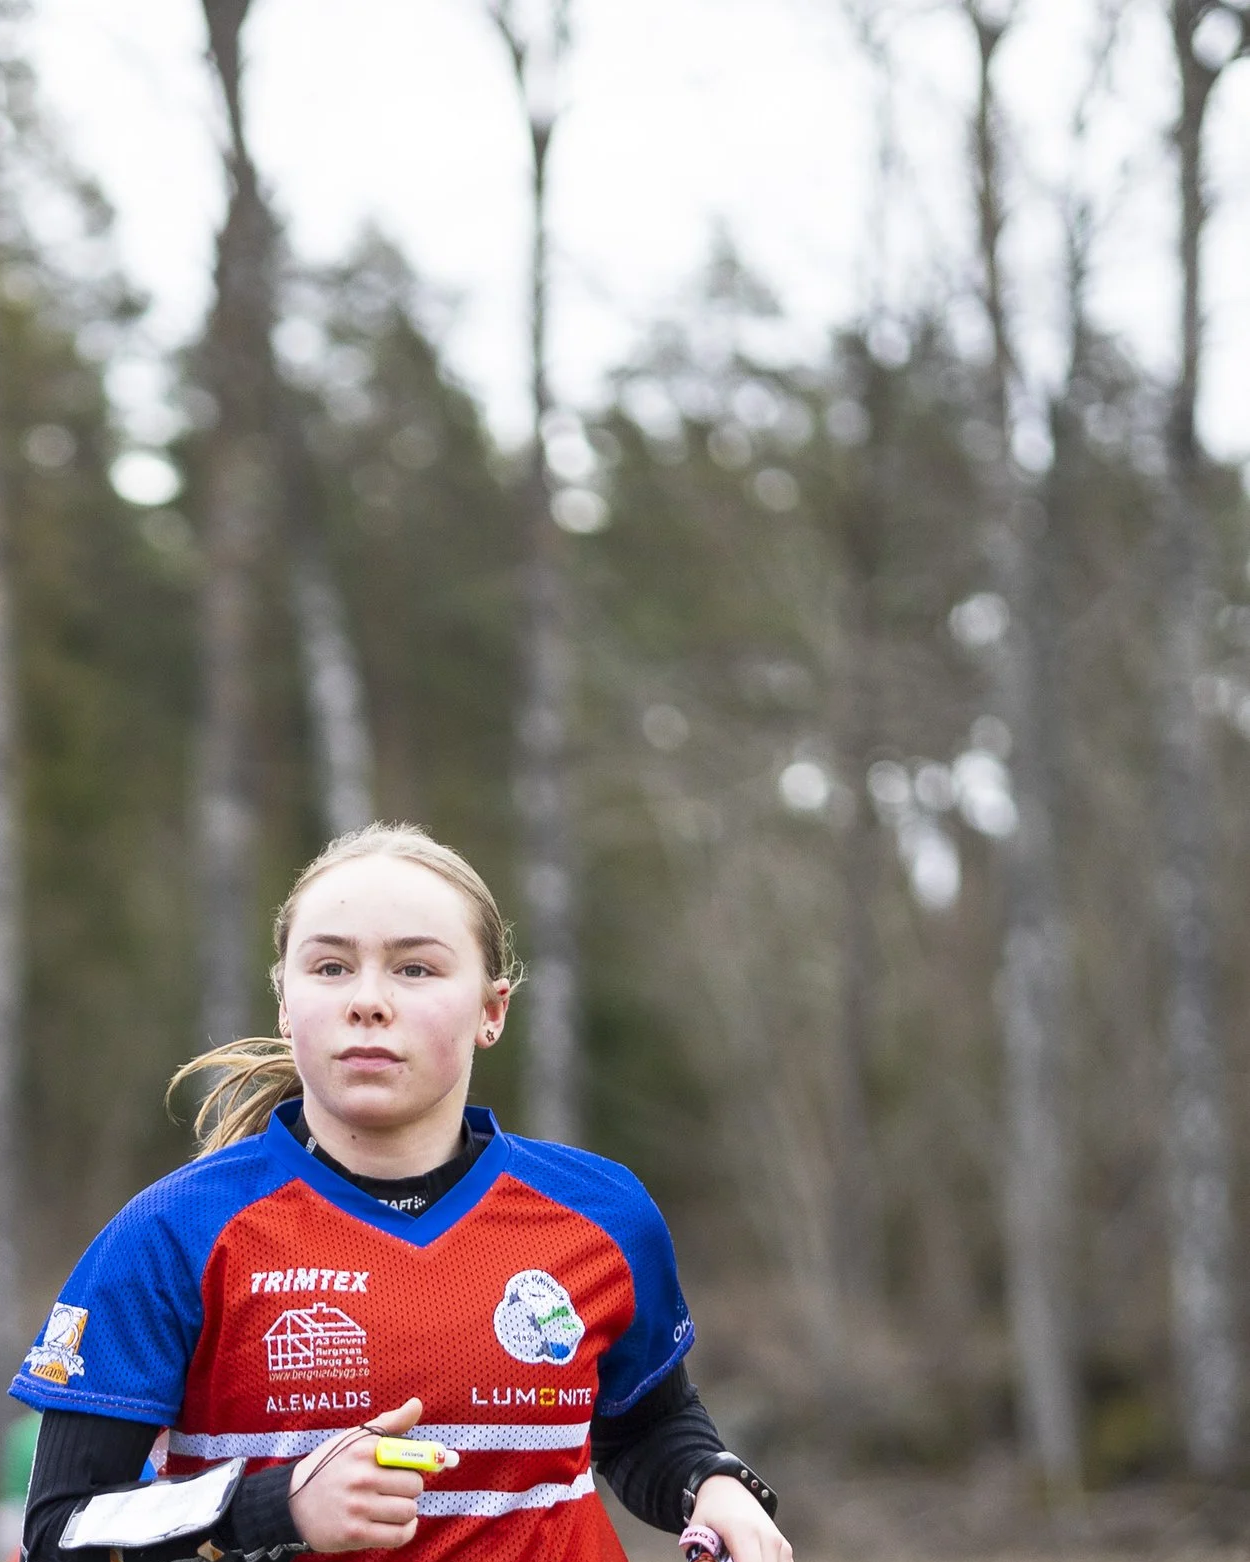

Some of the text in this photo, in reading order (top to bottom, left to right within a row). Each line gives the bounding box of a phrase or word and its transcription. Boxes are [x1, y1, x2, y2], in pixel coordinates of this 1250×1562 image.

[251, 1268, 370, 1294] TRIMTEX
[266, 1391, 371, 1413] ALEWALDS
[472, 1387, 592, 1405] LUMONITE
